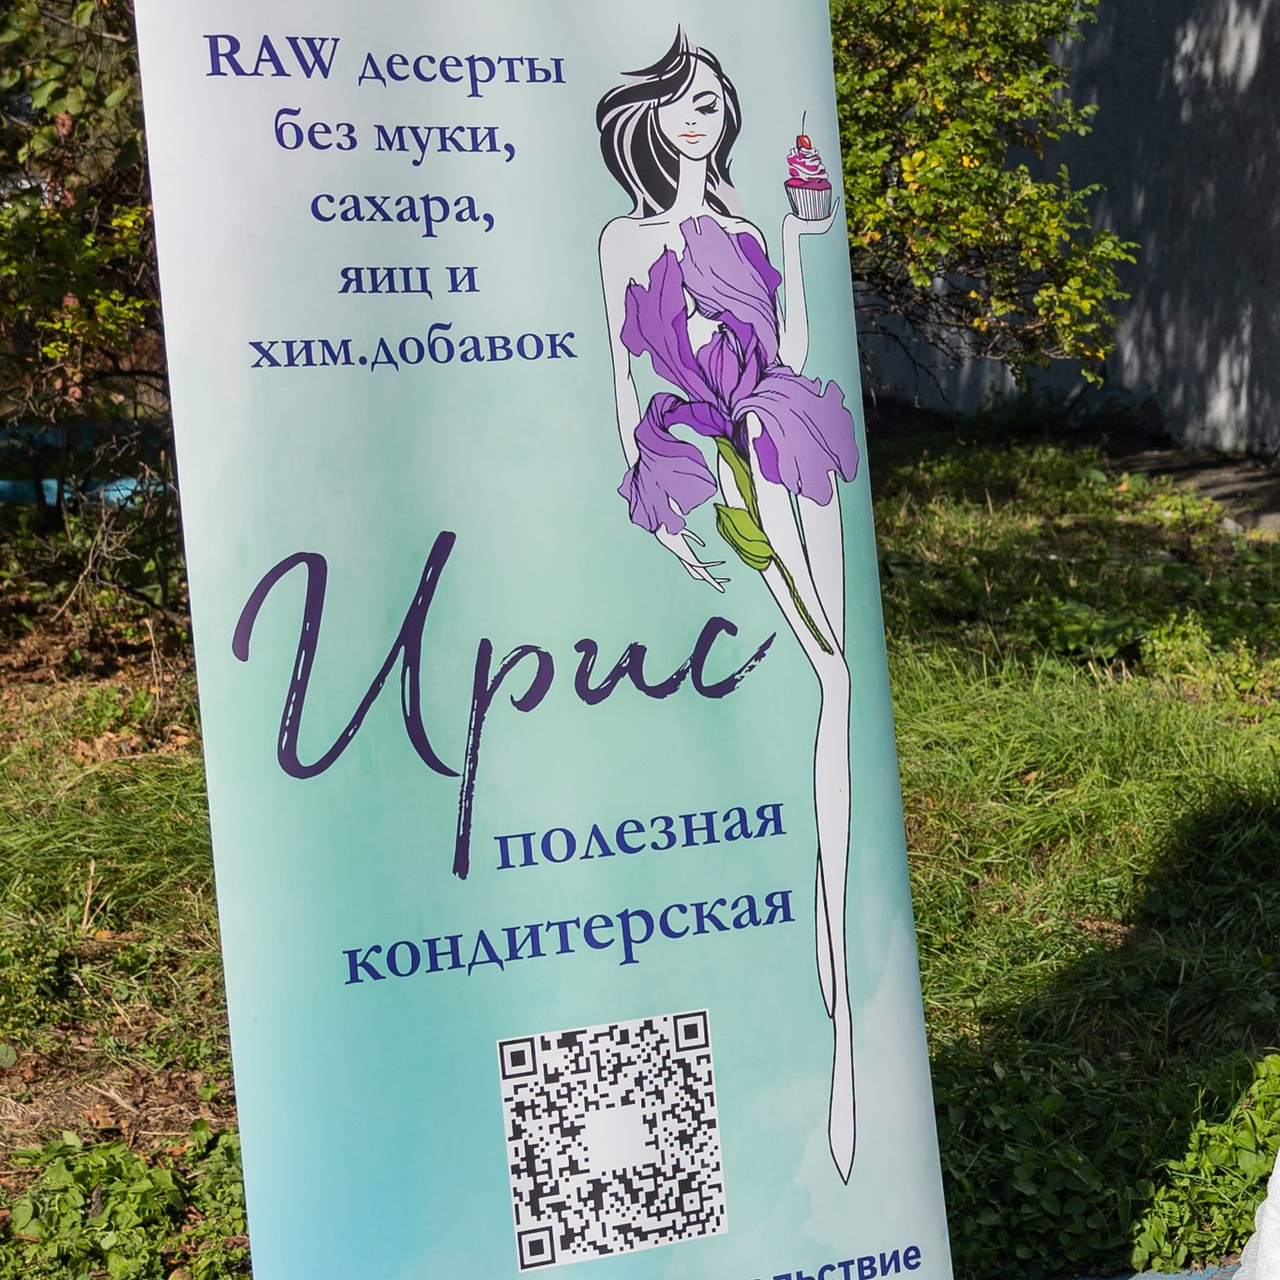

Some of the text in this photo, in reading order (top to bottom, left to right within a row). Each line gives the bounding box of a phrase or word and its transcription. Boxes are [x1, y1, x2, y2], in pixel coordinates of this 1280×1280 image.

[203, 35, 566, 97] RAW десерты
[275, 108, 515, 166] без муки,
[311, 194, 494, 238] сахара,
[338, 267, 479, 300] яиц и
[249, 322, 577, 372] хим.добавок
[232, 531, 777, 880] Ирис
[494, 803, 786, 870] полезная
[342, 890, 795, 985] кондитерская
